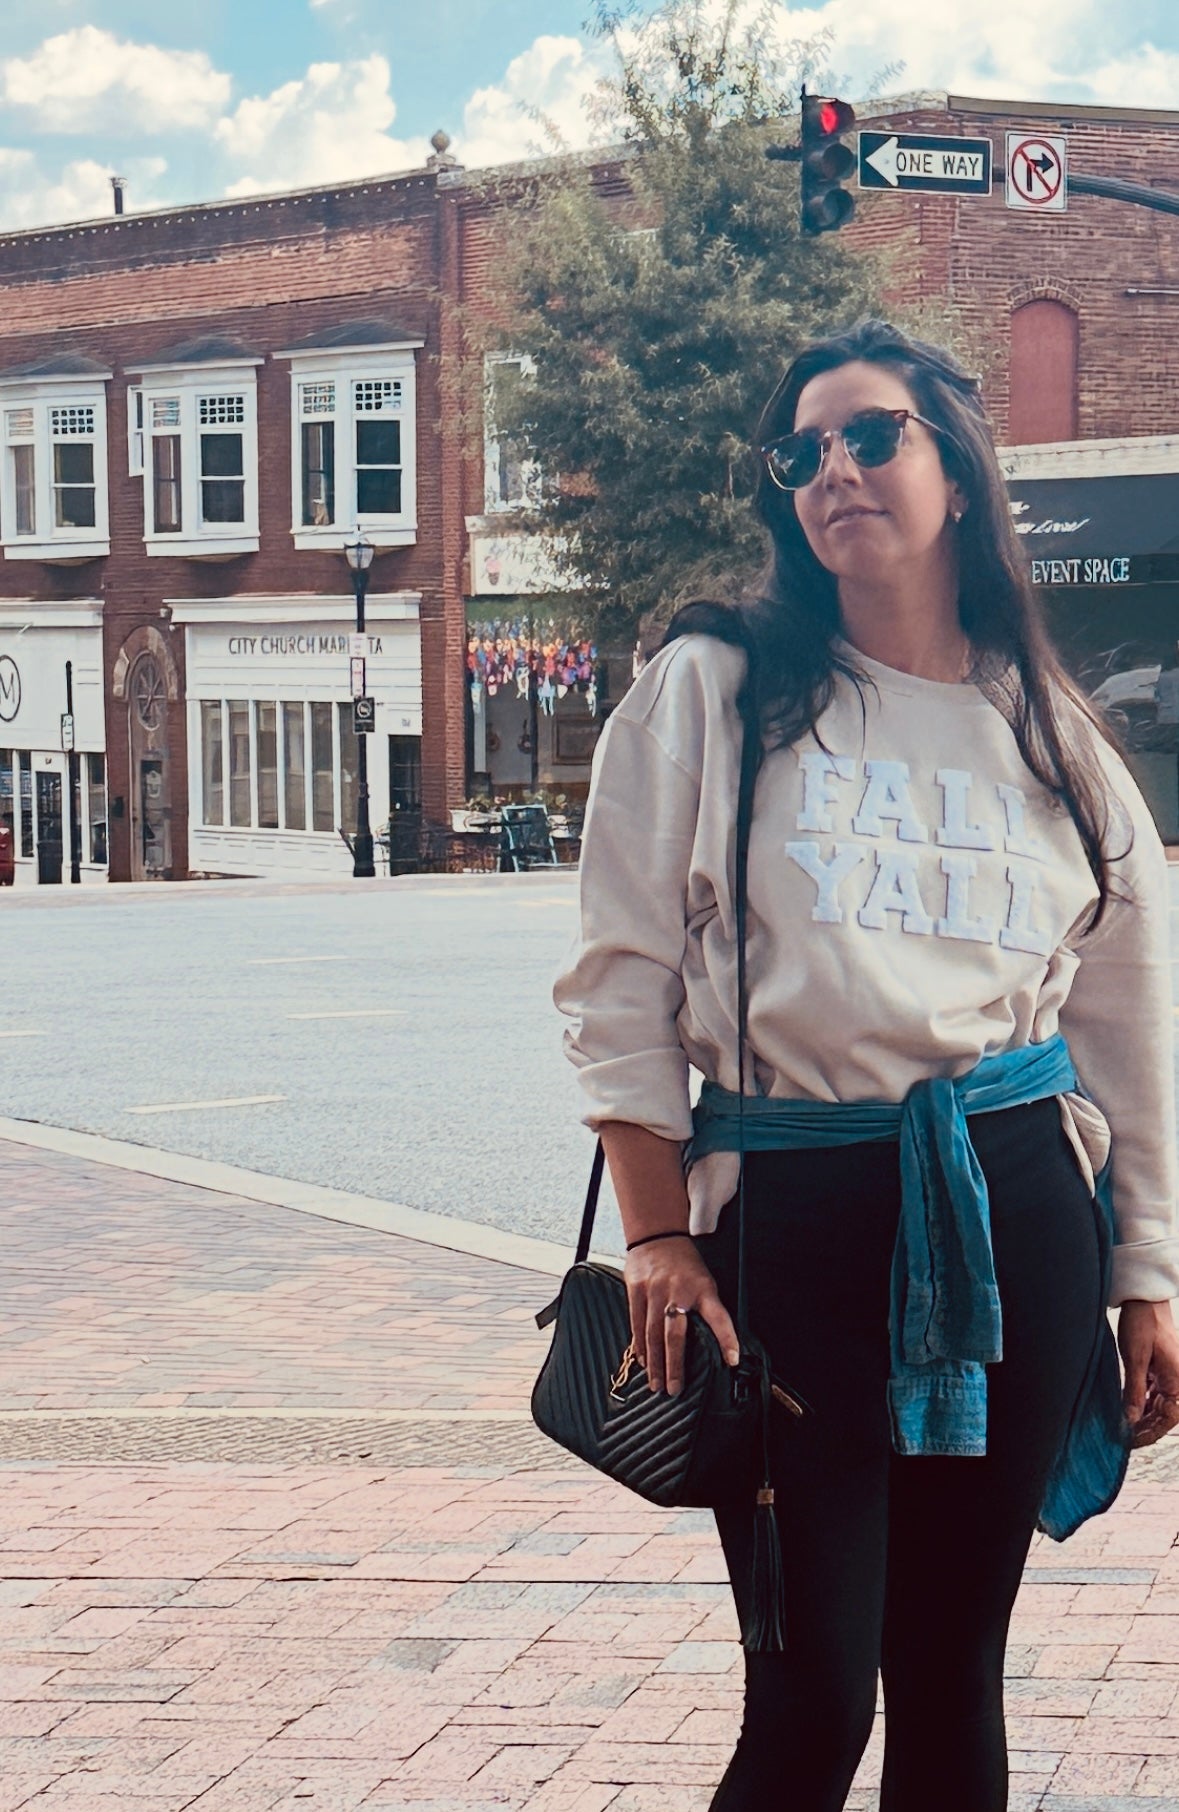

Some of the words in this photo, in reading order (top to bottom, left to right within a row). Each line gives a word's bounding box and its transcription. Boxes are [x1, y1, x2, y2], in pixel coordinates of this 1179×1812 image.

[896, 151, 933, 173] ONE
[942, 155, 979, 176] WAY
[1031, 559, 1081, 584] EVENT
[1084, 557, 1131, 583] SPACE
[228, 637, 257, 655] CITY
[260, 637, 315, 655] CHURCH
[796, 753, 1052, 863] FALL
[785, 840, 1052, 957] YALL
